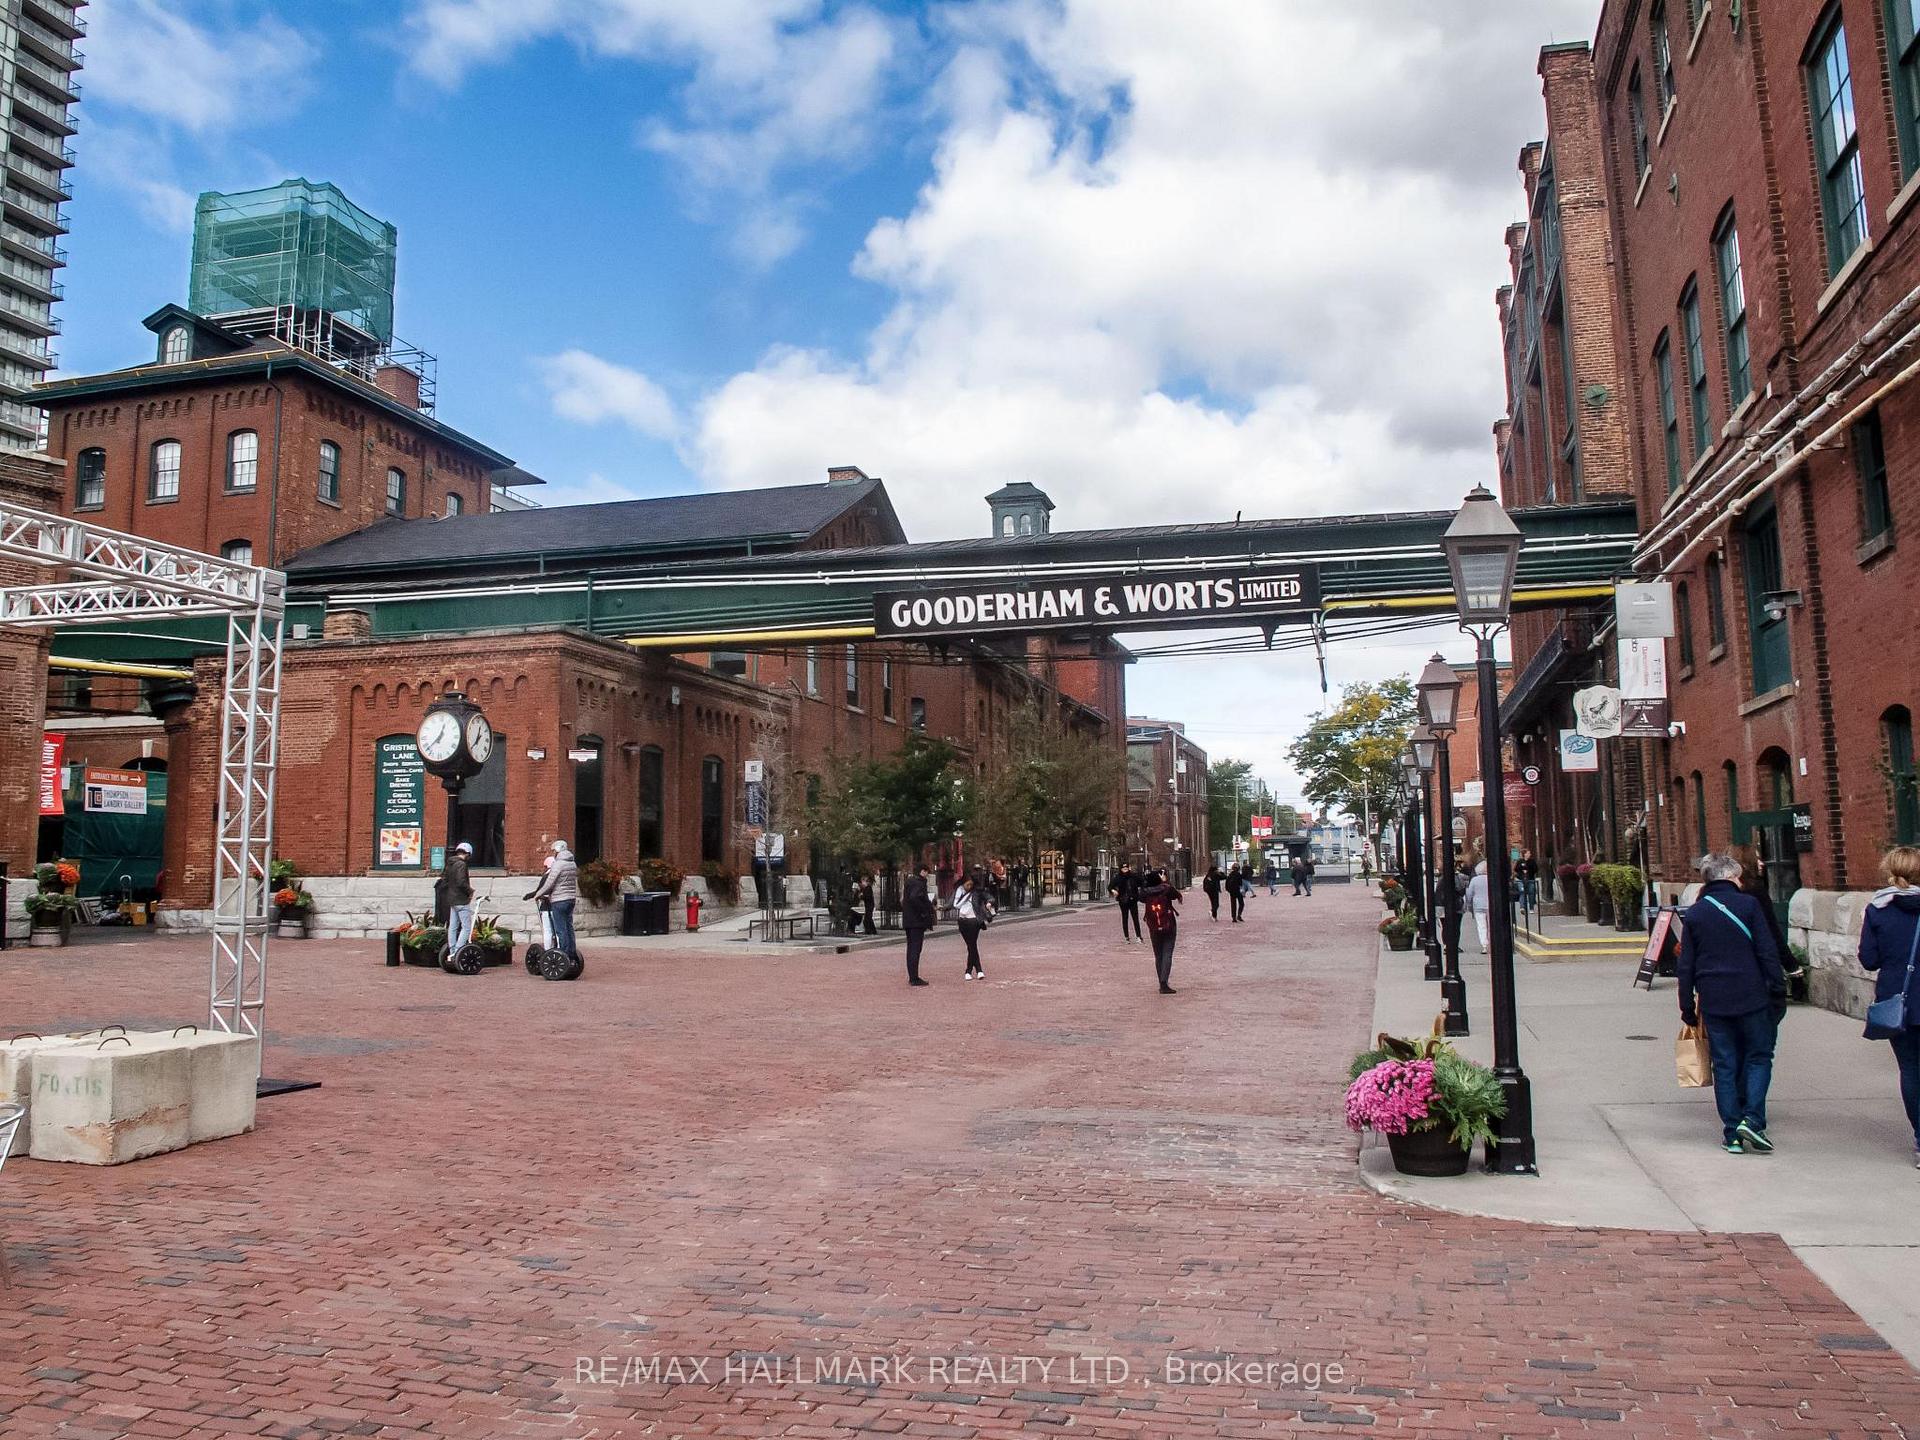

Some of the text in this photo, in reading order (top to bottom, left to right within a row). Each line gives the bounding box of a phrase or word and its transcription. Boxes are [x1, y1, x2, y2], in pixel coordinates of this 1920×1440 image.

[891, 578, 1300, 628] GOODERHAM & WORTS LIMITED
[38, 1073, 103, 1096] FOTIS
